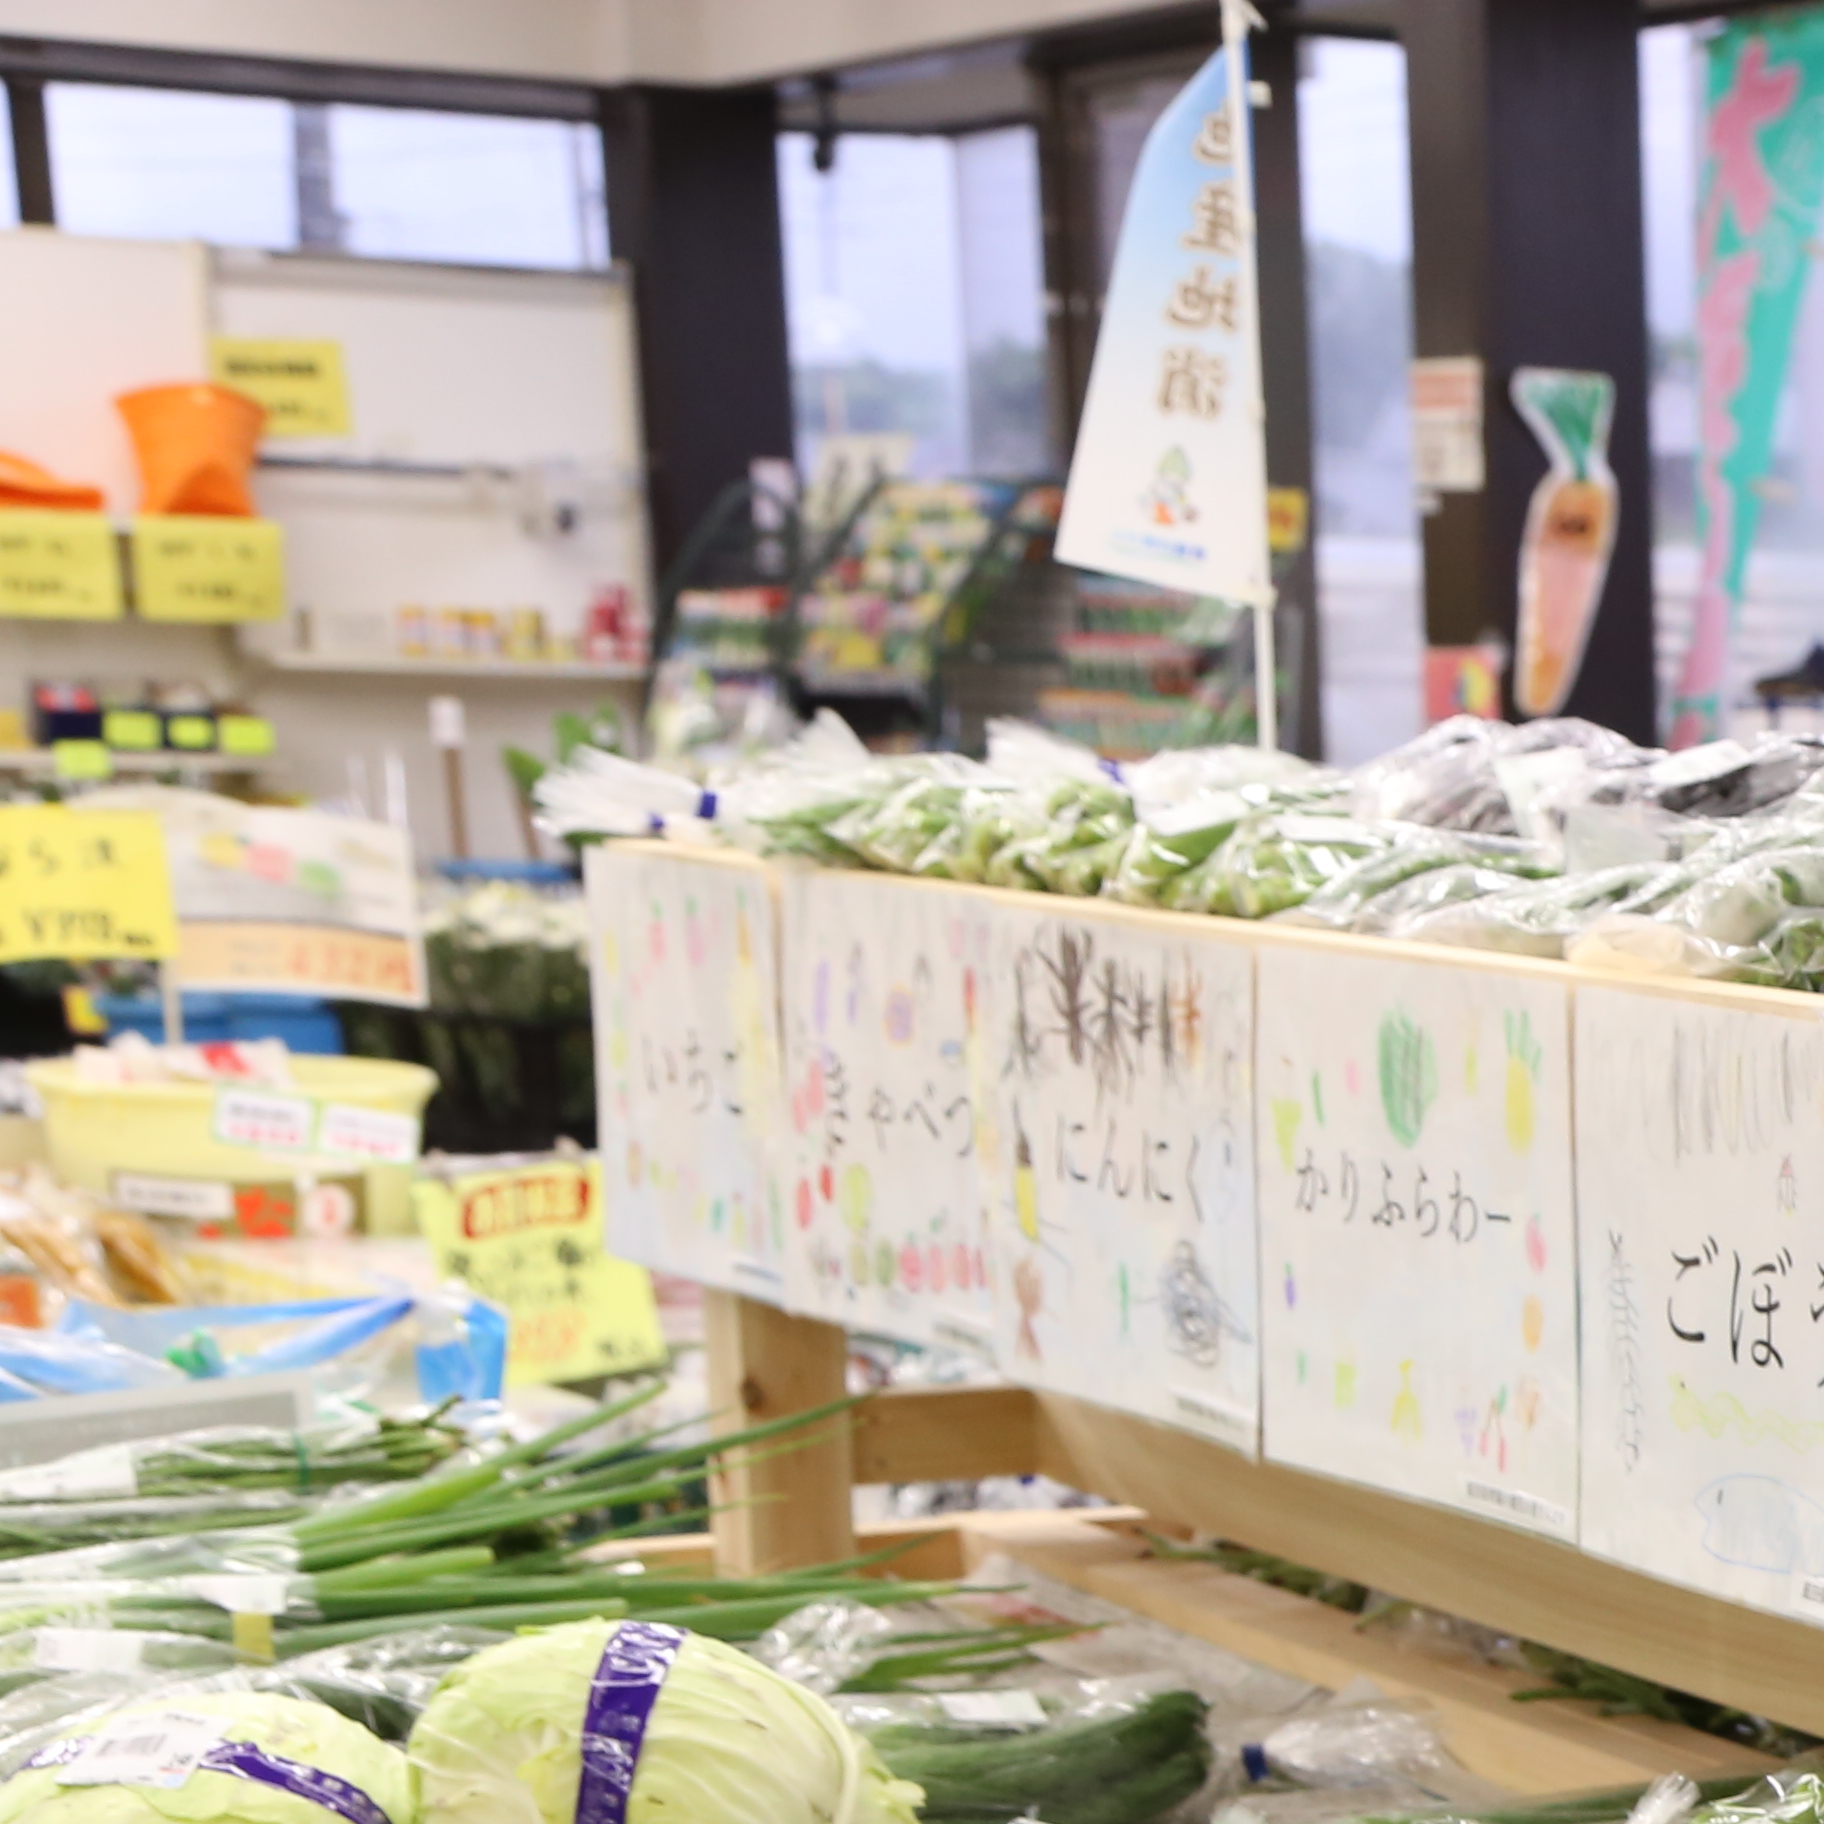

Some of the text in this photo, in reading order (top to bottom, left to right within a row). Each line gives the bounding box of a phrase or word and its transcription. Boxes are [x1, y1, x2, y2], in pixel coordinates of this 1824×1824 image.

[1057, 1112, 1204, 1223] にんにく
[1296, 1149, 1512, 1244] かりふらわー
